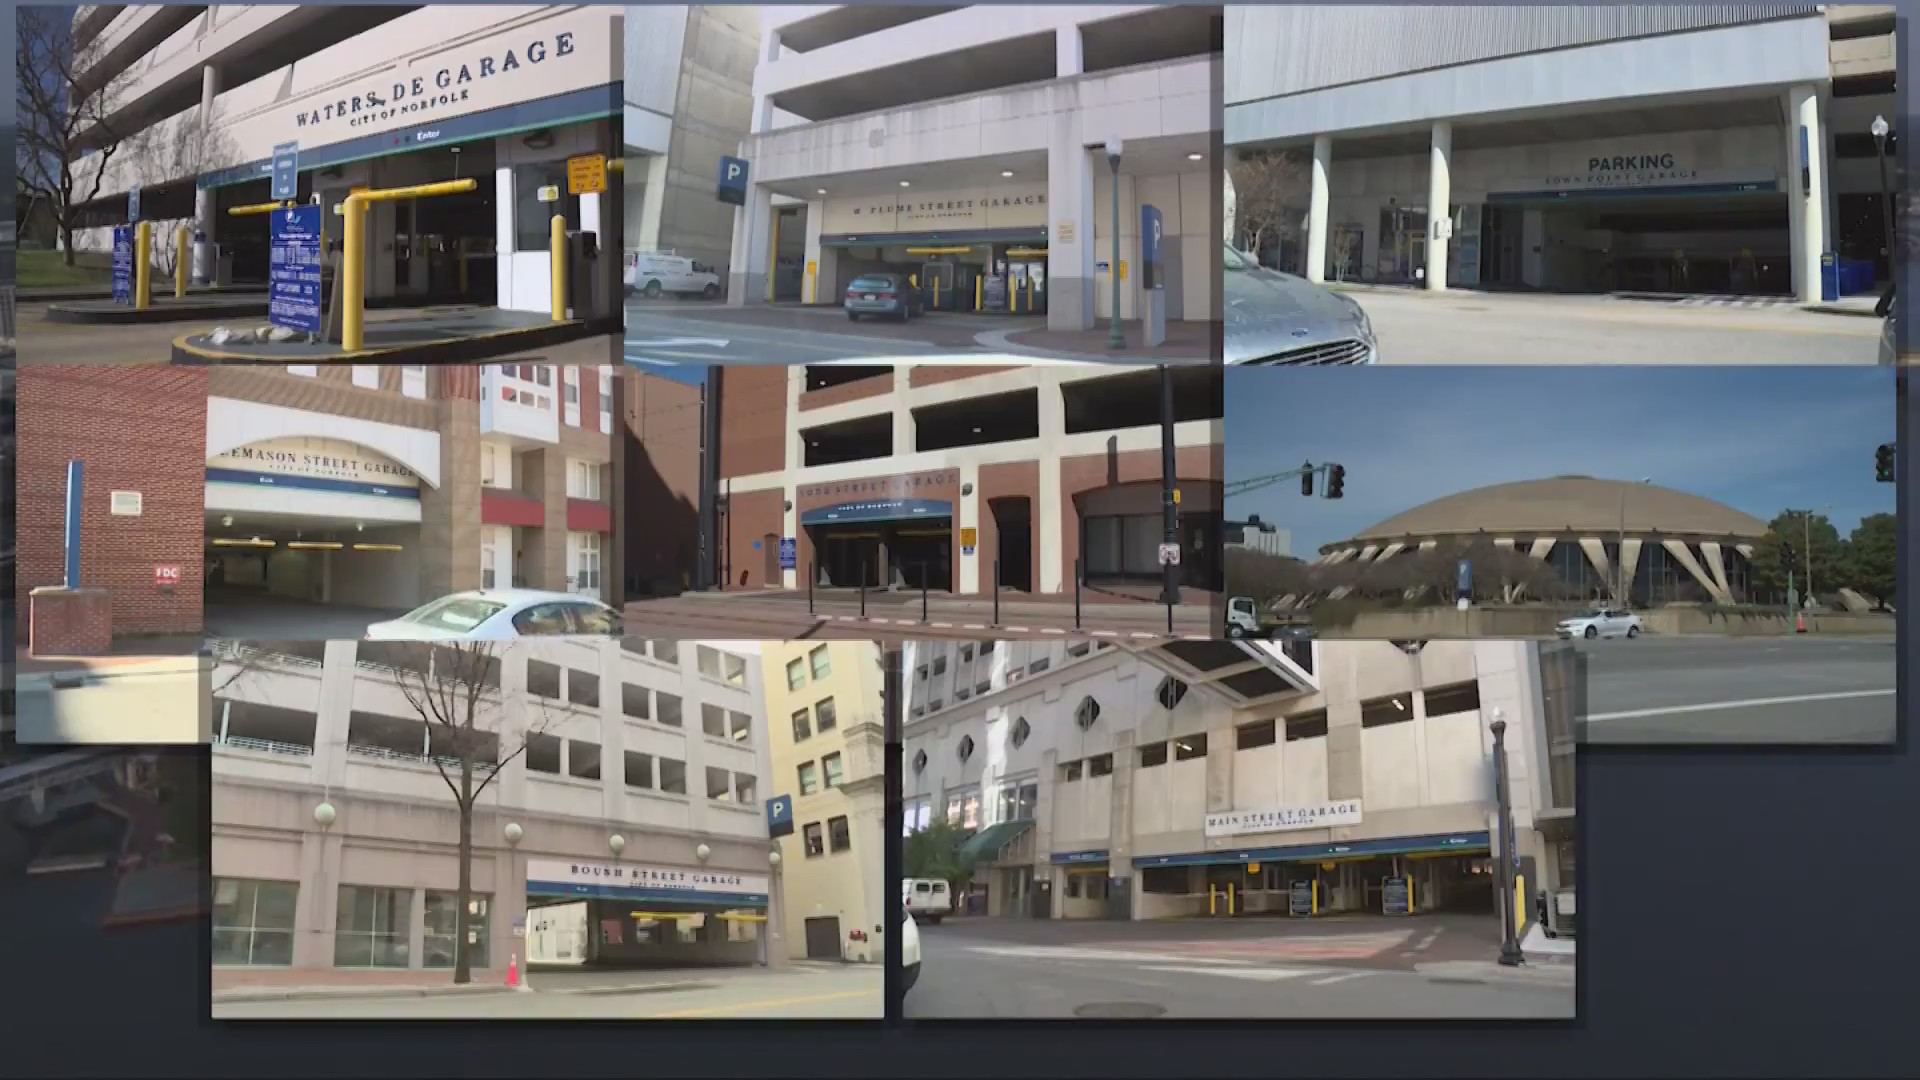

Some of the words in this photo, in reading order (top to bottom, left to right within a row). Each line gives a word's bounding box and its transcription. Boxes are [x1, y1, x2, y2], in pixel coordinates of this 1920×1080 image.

[435, 31, 575, 89] GARAGE
[350, 112, 377, 127] CITY
[381, 108, 396, 120] OF
[401, 89, 469, 114] NORFOLK
[727, 162, 741, 180] P
[1588, 153, 1675, 172] PARKING
[918, 200, 974, 211] STREET
[980, 194, 1046, 208] GARAGE
[303, 455, 359, 471] STREET
[772, 801, 784, 818] P
[1208, 816, 1239, 828] MAIN
[1243, 808, 1293, 824] STREET
[1298, 803, 1358, 818] GARAGE
[571, 864, 624, 878] BOUSH
[631, 868, 686, 882] STREET
[692, 873, 742, 886] GARAGE
